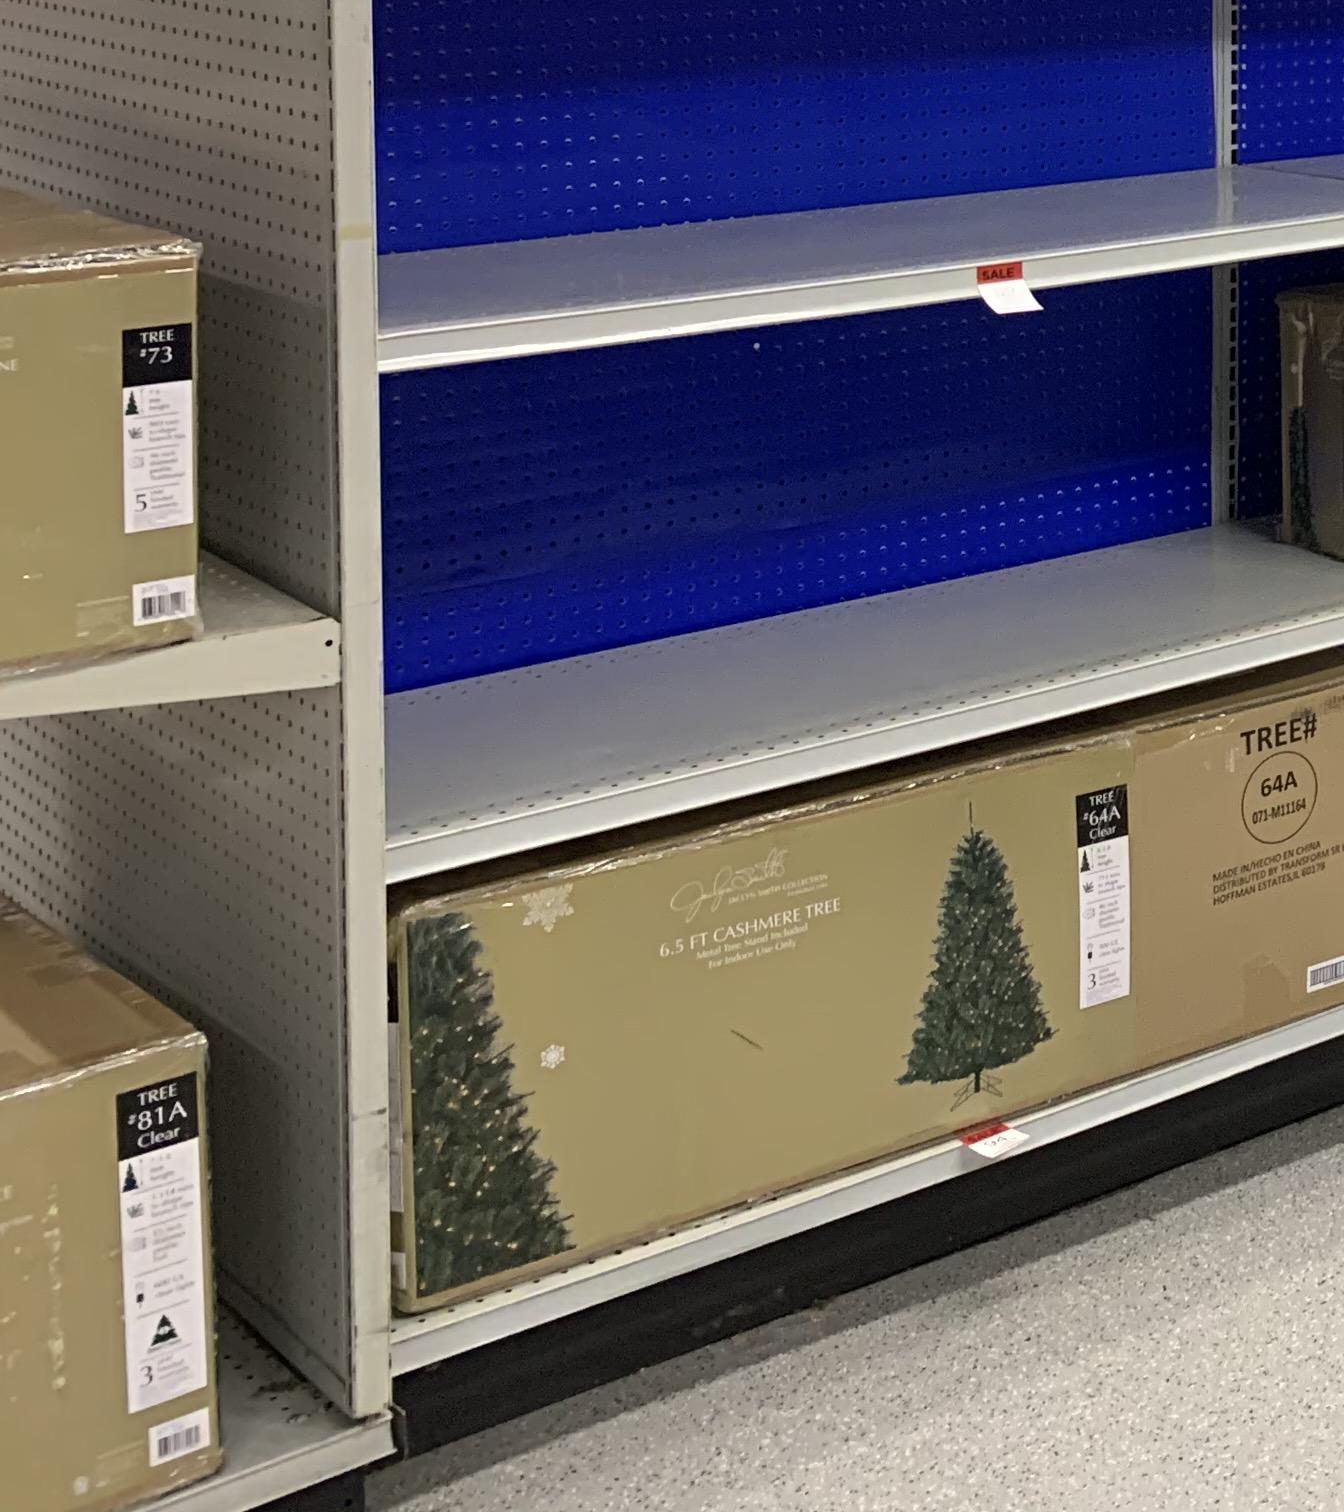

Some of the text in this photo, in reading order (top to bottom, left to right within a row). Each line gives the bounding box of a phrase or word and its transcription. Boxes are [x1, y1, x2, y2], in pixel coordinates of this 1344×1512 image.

[982, 267, 1015, 281] SALE
[140, 328, 175, 345] TREE
[140, 346, 173, 365] #73
[134, 493, 147, 512] 5
[1240, 713, 1317, 755] TREE#
[1261, 771, 1298, 797] 64A
[1089, 790, 1114, 807] TREE
[1089, 825, 1117, 840] Clear
[1213, 866, 1238, 882] MADE
[1283, 849, 1294, 861] EN
[1296, 841, 1321, 856] CHINA
[1213, 870, 1267, 894] DISTRIBUTED
[1268, 866, 1278, 877] BY
[1213, 885, 1256, 906] HOFFMAN
[659, 897, 841, 958] 6.5 FT CASHMERE TREE
[775, 939, 797, 952] Only
[1088, 973, 1096, 990] 3
[137, 1083, 178, 1106] TREE
[137, 1127, 181, 1149] Clear
[139, 1365, 153, 1386] 3
